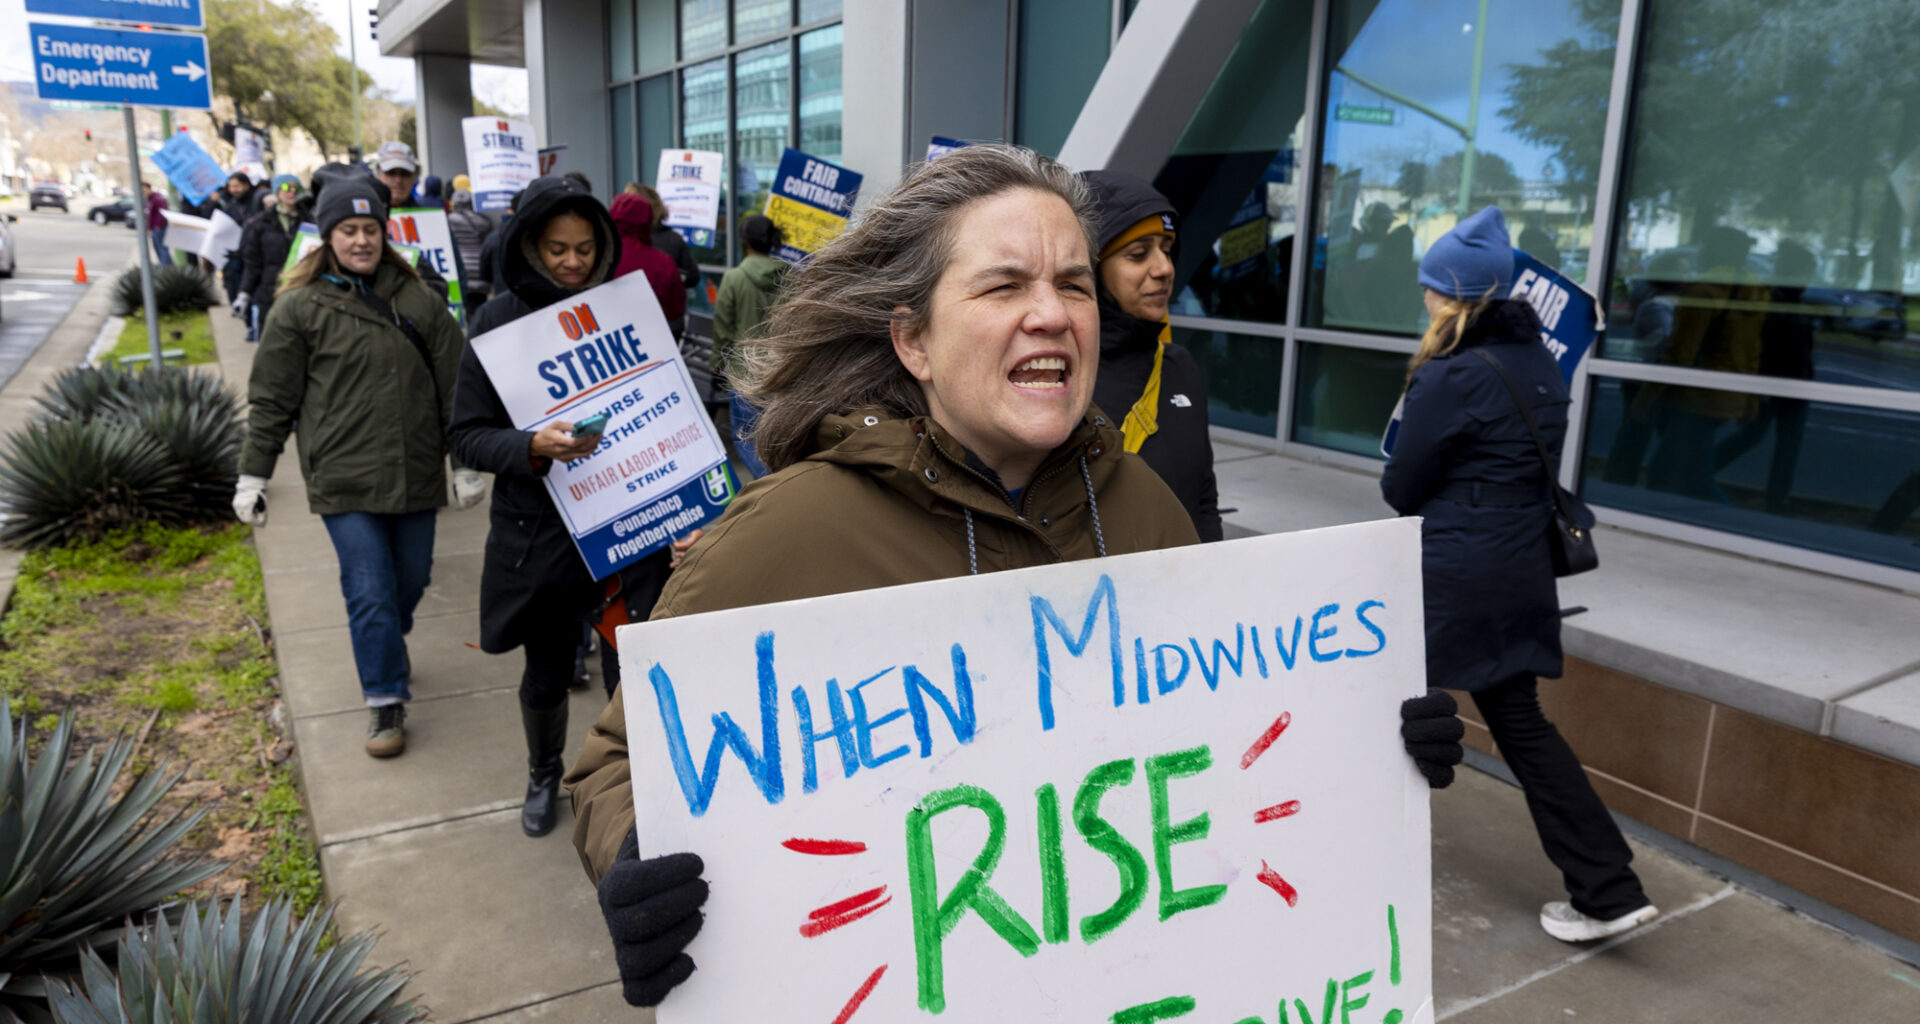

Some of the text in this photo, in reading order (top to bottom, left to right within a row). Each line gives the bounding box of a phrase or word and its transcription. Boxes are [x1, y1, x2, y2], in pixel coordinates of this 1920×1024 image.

[38, 35, 151, 68] Emergency
[41, 62, 159, 90] Department
[482, 132, 524, 152] STRIKE
[671, 164, 703, 180] STRIKE
[802, 159, 839, 189] FAIR
[783, 176, 846, 210] CONTRACT
[1508, 268, 1569, 331] FAIR
[557, 301, 600, 341] ON
[537, 323, 649, 400] STRIKE
[593, 388, 644, 419] URSE
[567, 391, 681, 472] ASTHETISTS
[569, 421, 704, 501] UNFAIR LABOR PRACTICE
[626, 460, 678, 493] STRIKE
[607, 504, 705, 564] #TogetherWeRise
[613, 494, 683, 537] @unacuhcp
[649, 573, 1386, 818] WHEN MIDWIVES
[905, 745, 1228, 1014] RISE
